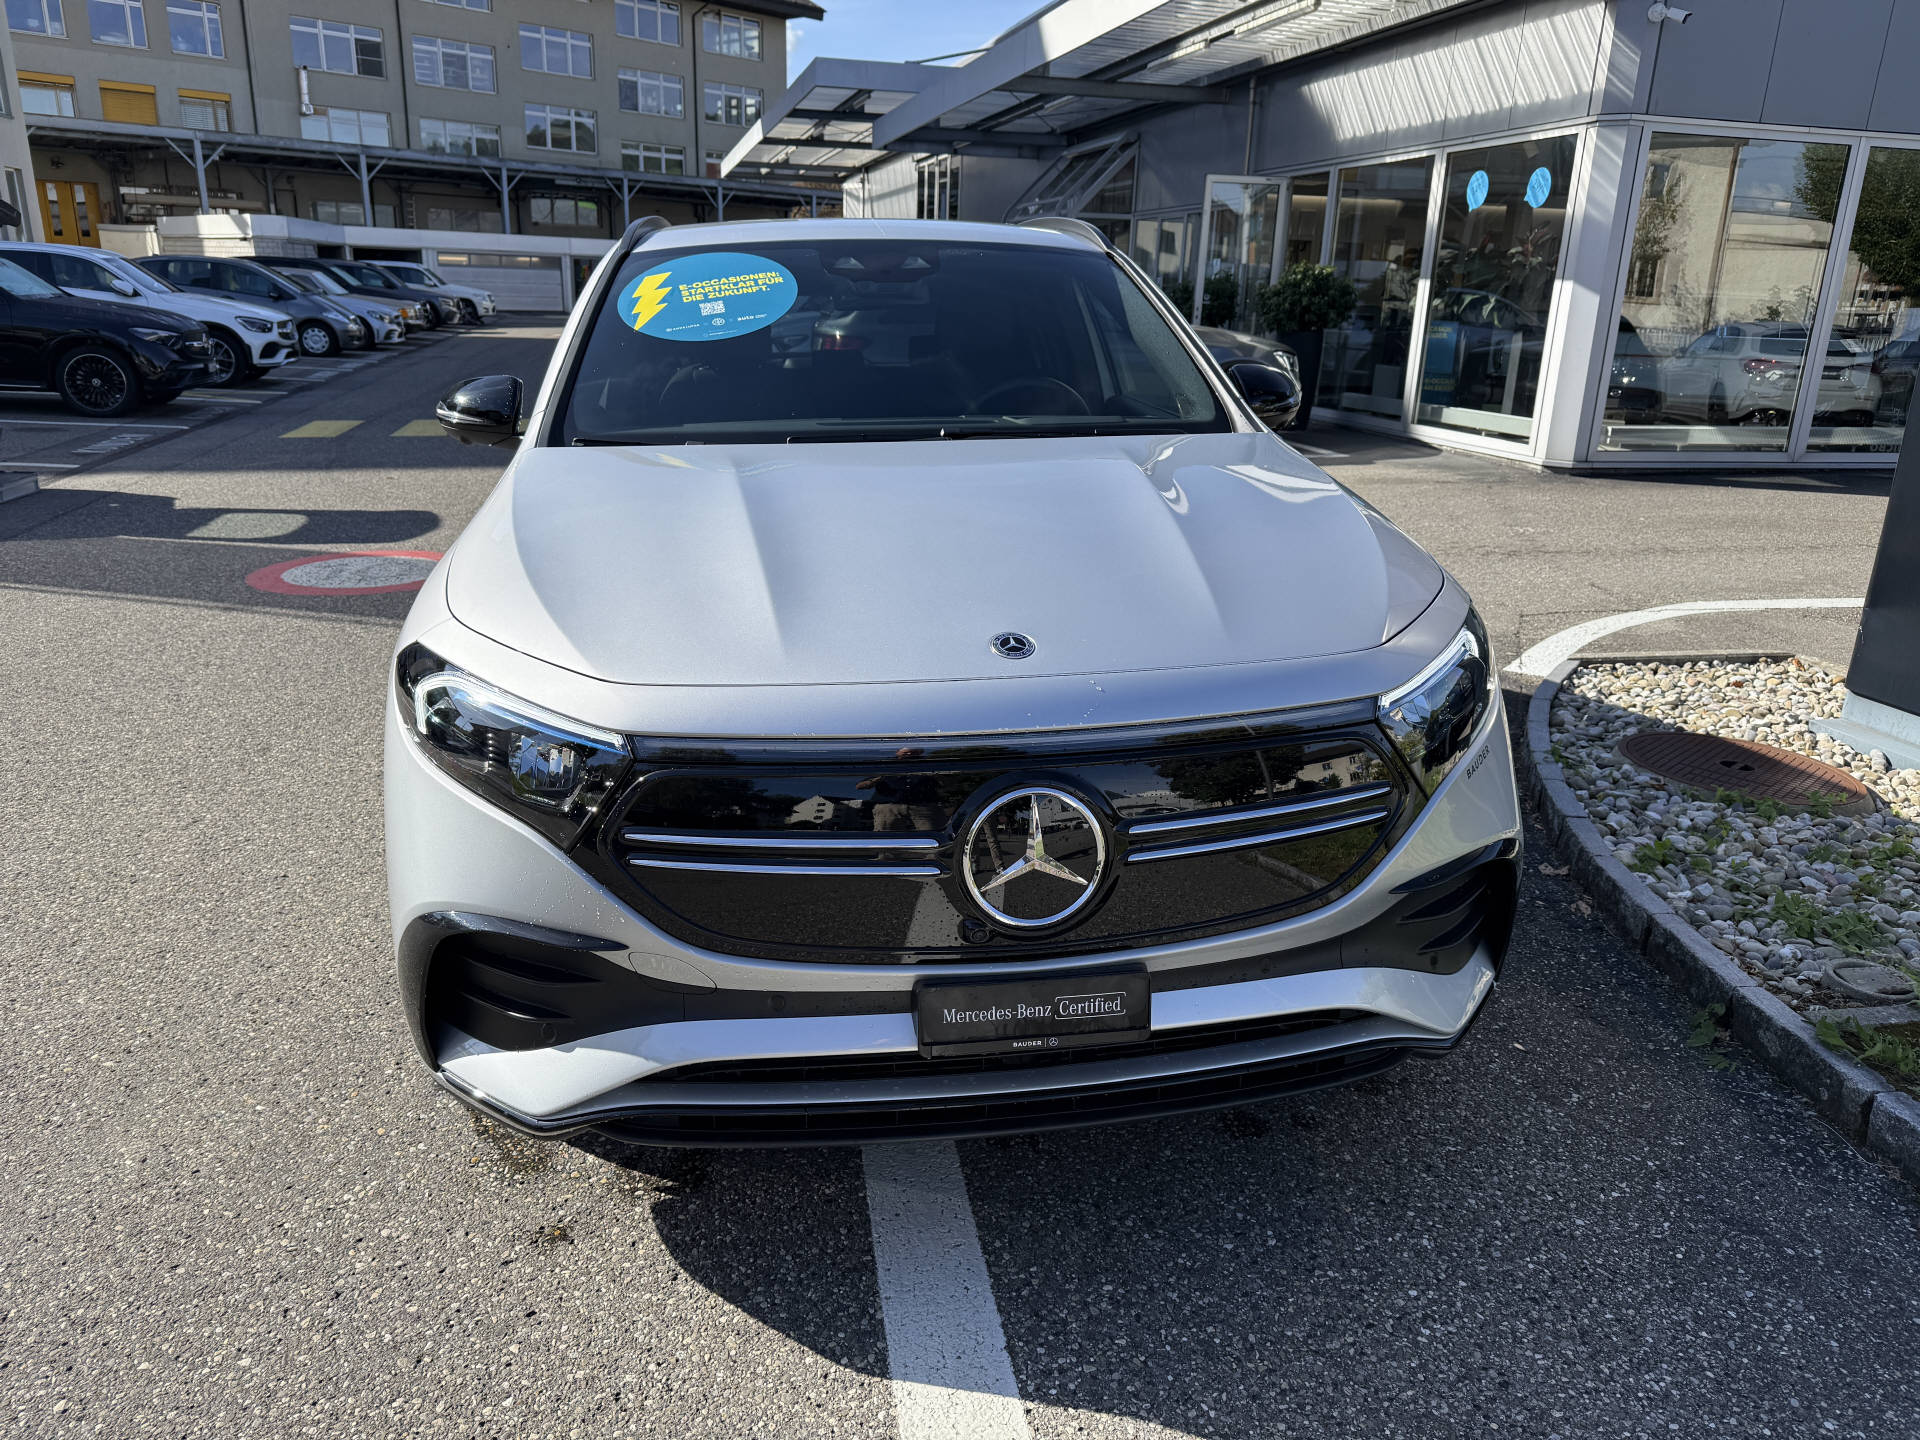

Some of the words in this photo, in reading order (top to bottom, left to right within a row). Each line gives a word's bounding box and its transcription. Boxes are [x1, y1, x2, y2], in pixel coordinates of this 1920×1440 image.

[679, 271, 780, 290] E-OCCASIONEN:
[681, 280, 755, 297] STARTKLAR
[758, 275, 784, 286] FÜR
[683, 293, 705, 303] DIE
[708, 285, 770, 299] ZUKUNFT.
[1466, 745, 1490, 780] BAUDER
[943, 1003, 1052, 1023] Mercedes-Benz
[1059, 997, 1121, 1016] Certified
[1013, 1040, 1042, 1048] BAUDER
